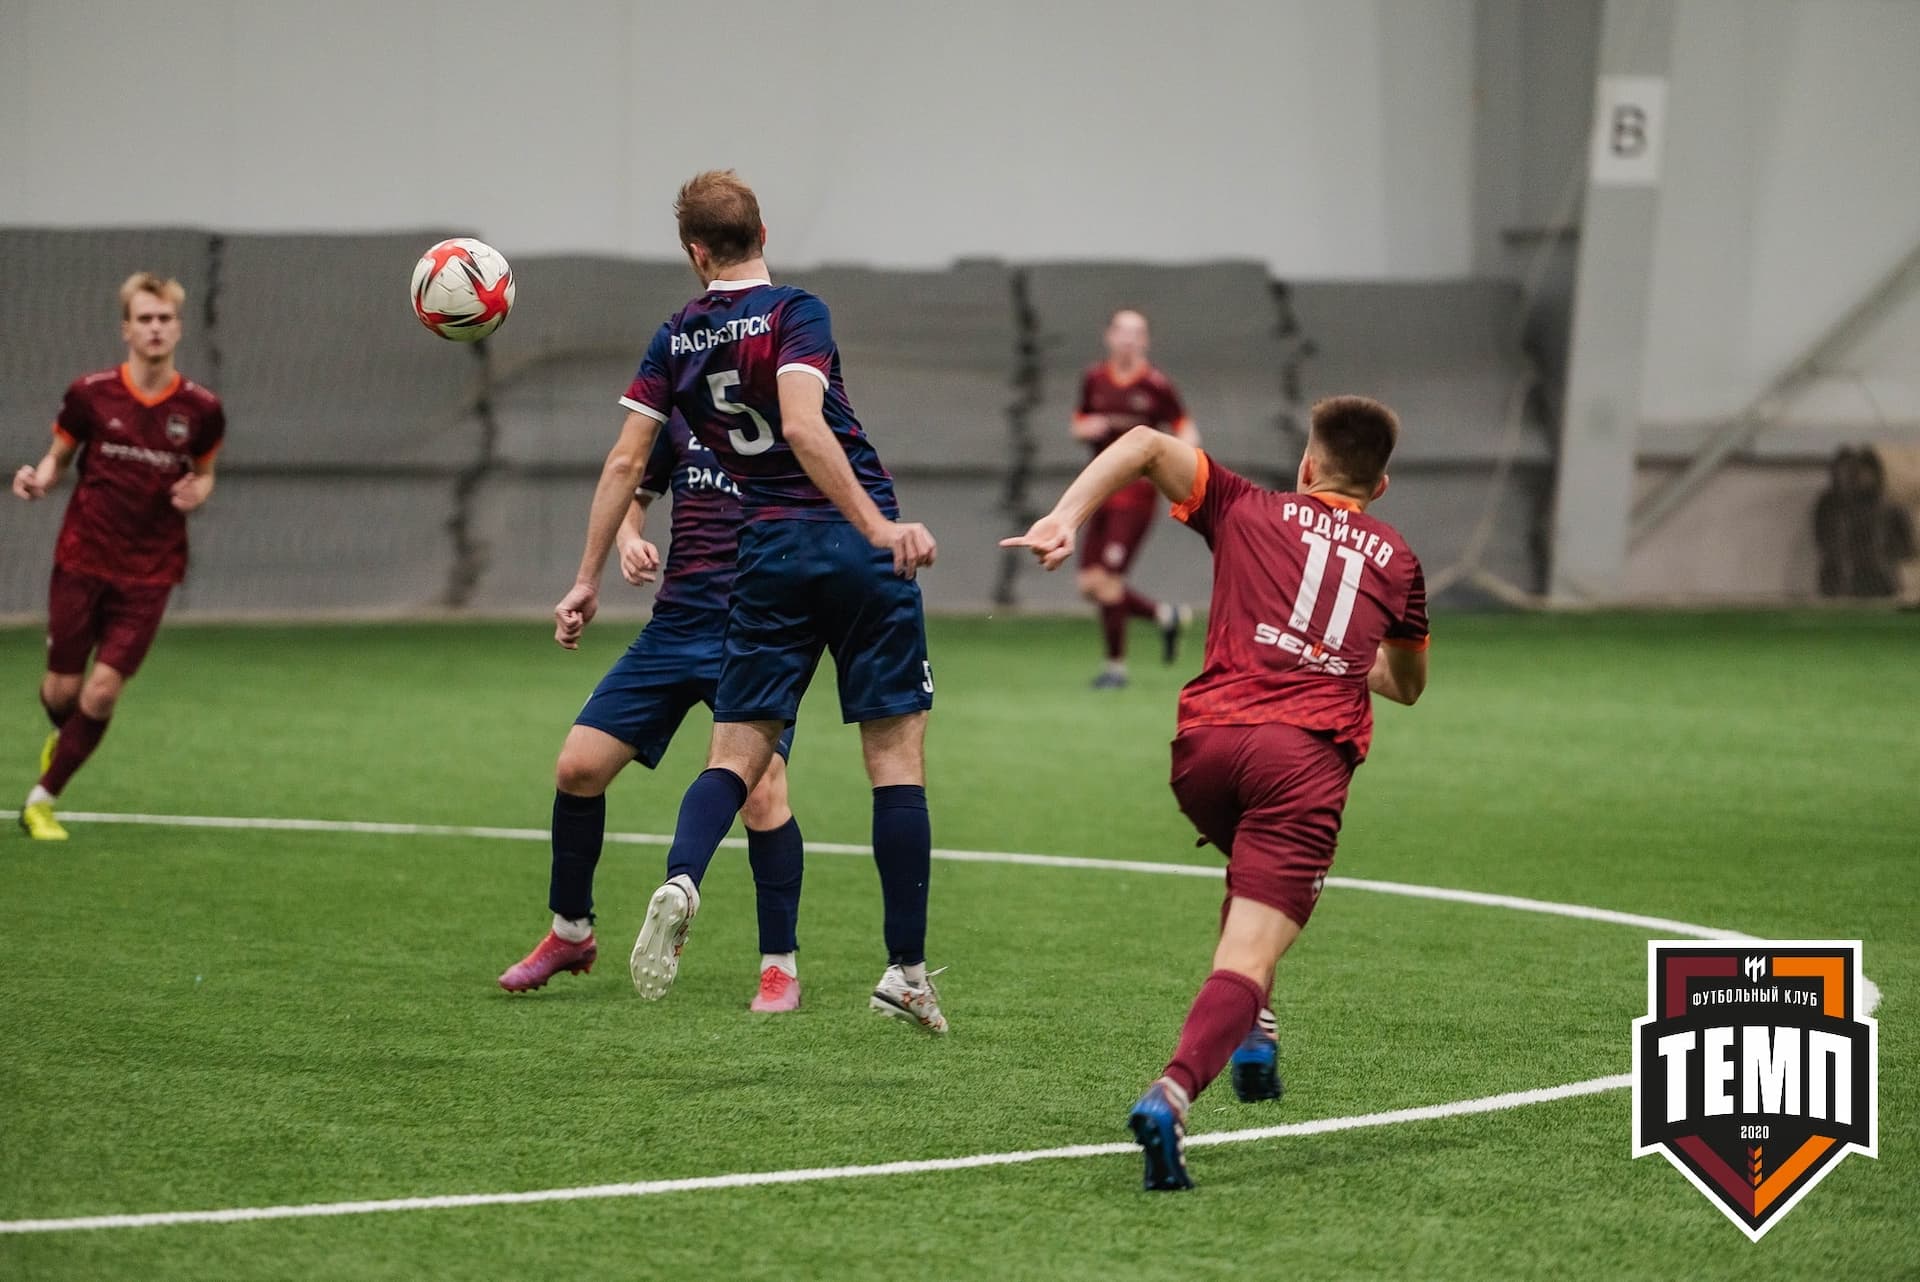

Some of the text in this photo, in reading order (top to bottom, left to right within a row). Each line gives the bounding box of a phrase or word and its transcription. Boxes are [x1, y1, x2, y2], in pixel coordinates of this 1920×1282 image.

[706, 369, 775, 457] 5
[1283, 502, 1394, 568] РОДИЧЕВ
[1288, 530, 1366, 651] 11
